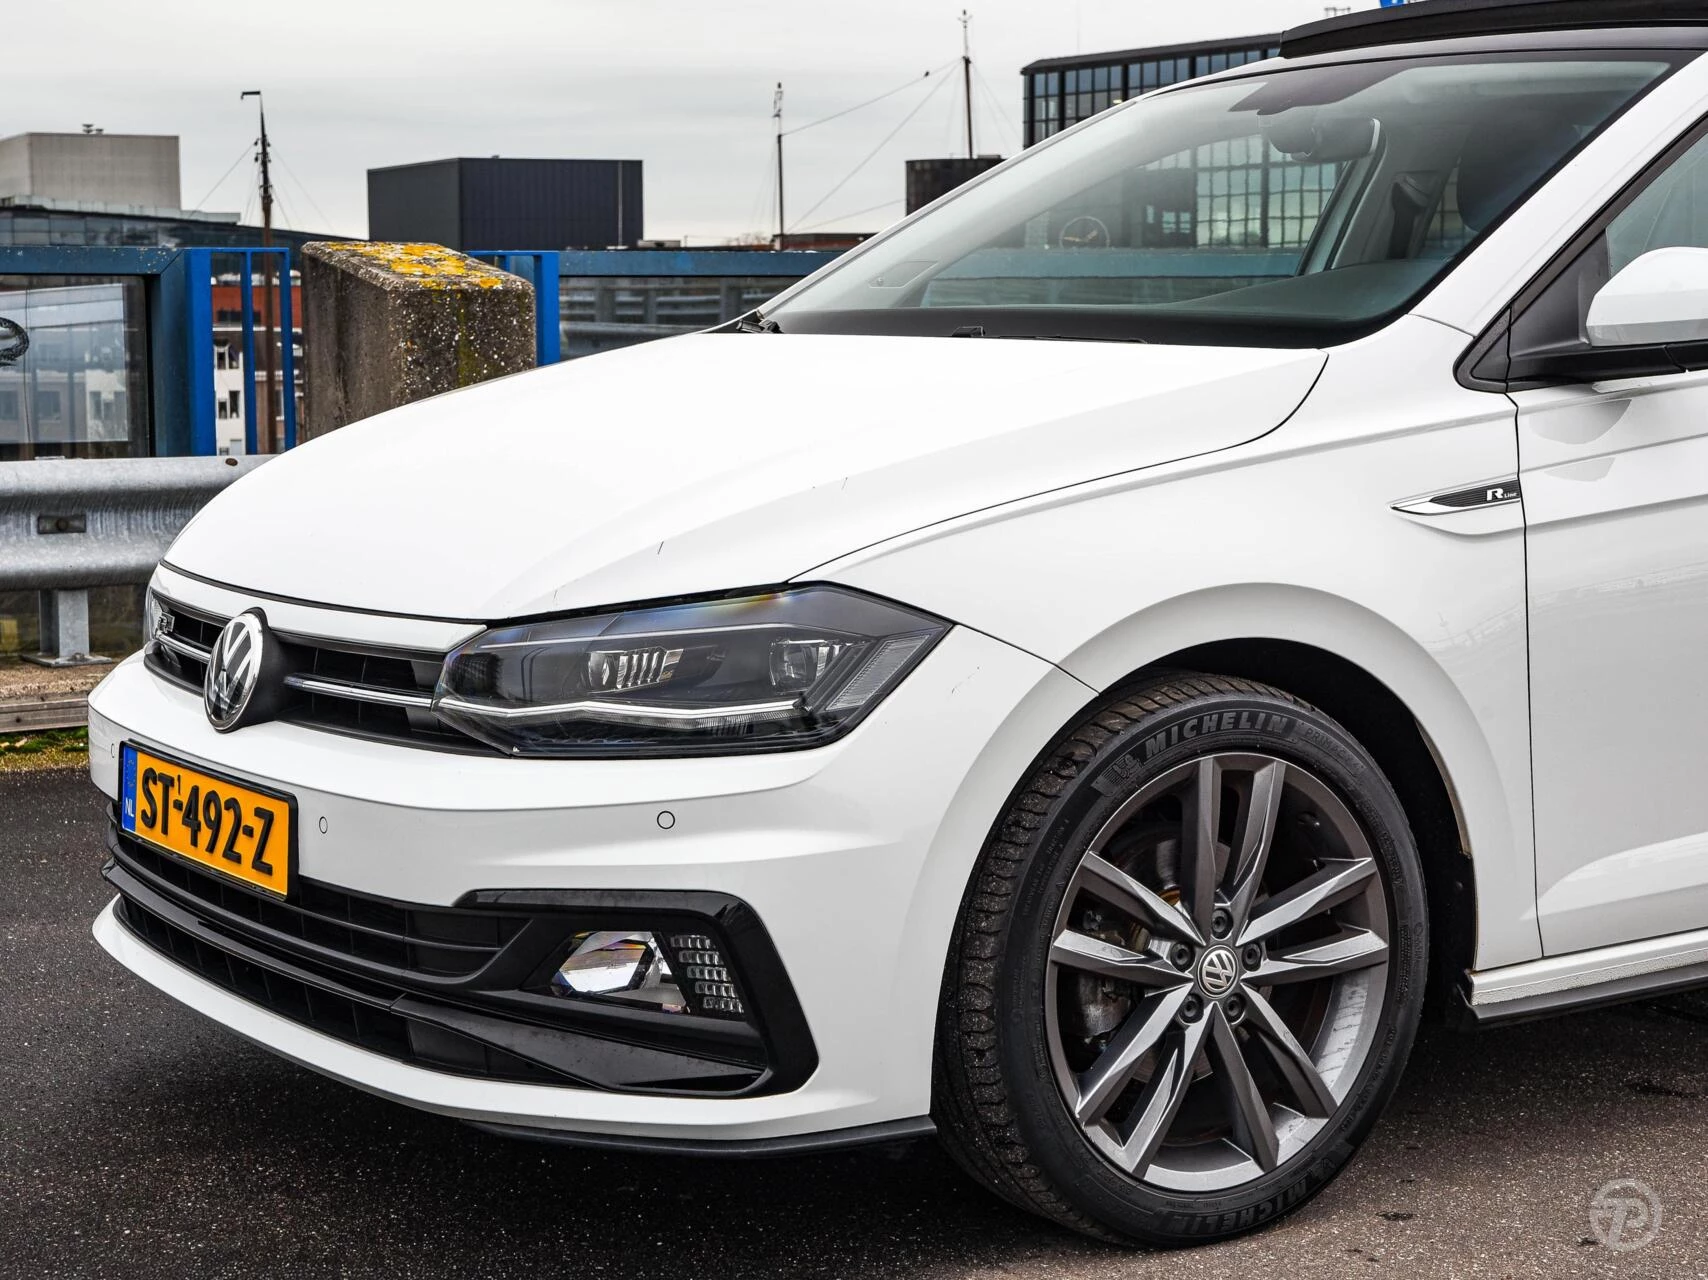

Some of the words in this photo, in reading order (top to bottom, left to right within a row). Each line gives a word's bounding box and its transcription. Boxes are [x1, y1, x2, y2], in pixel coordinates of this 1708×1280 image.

[1486, 487, 1504, 501] R
[1144, 710, 1288, 757] MICHELIN
[125, 796, 135, 818] NL
[140, 767, 275, 876] ST-492-Z
[1171, 1178, 1307, 1234] MICHELIN
